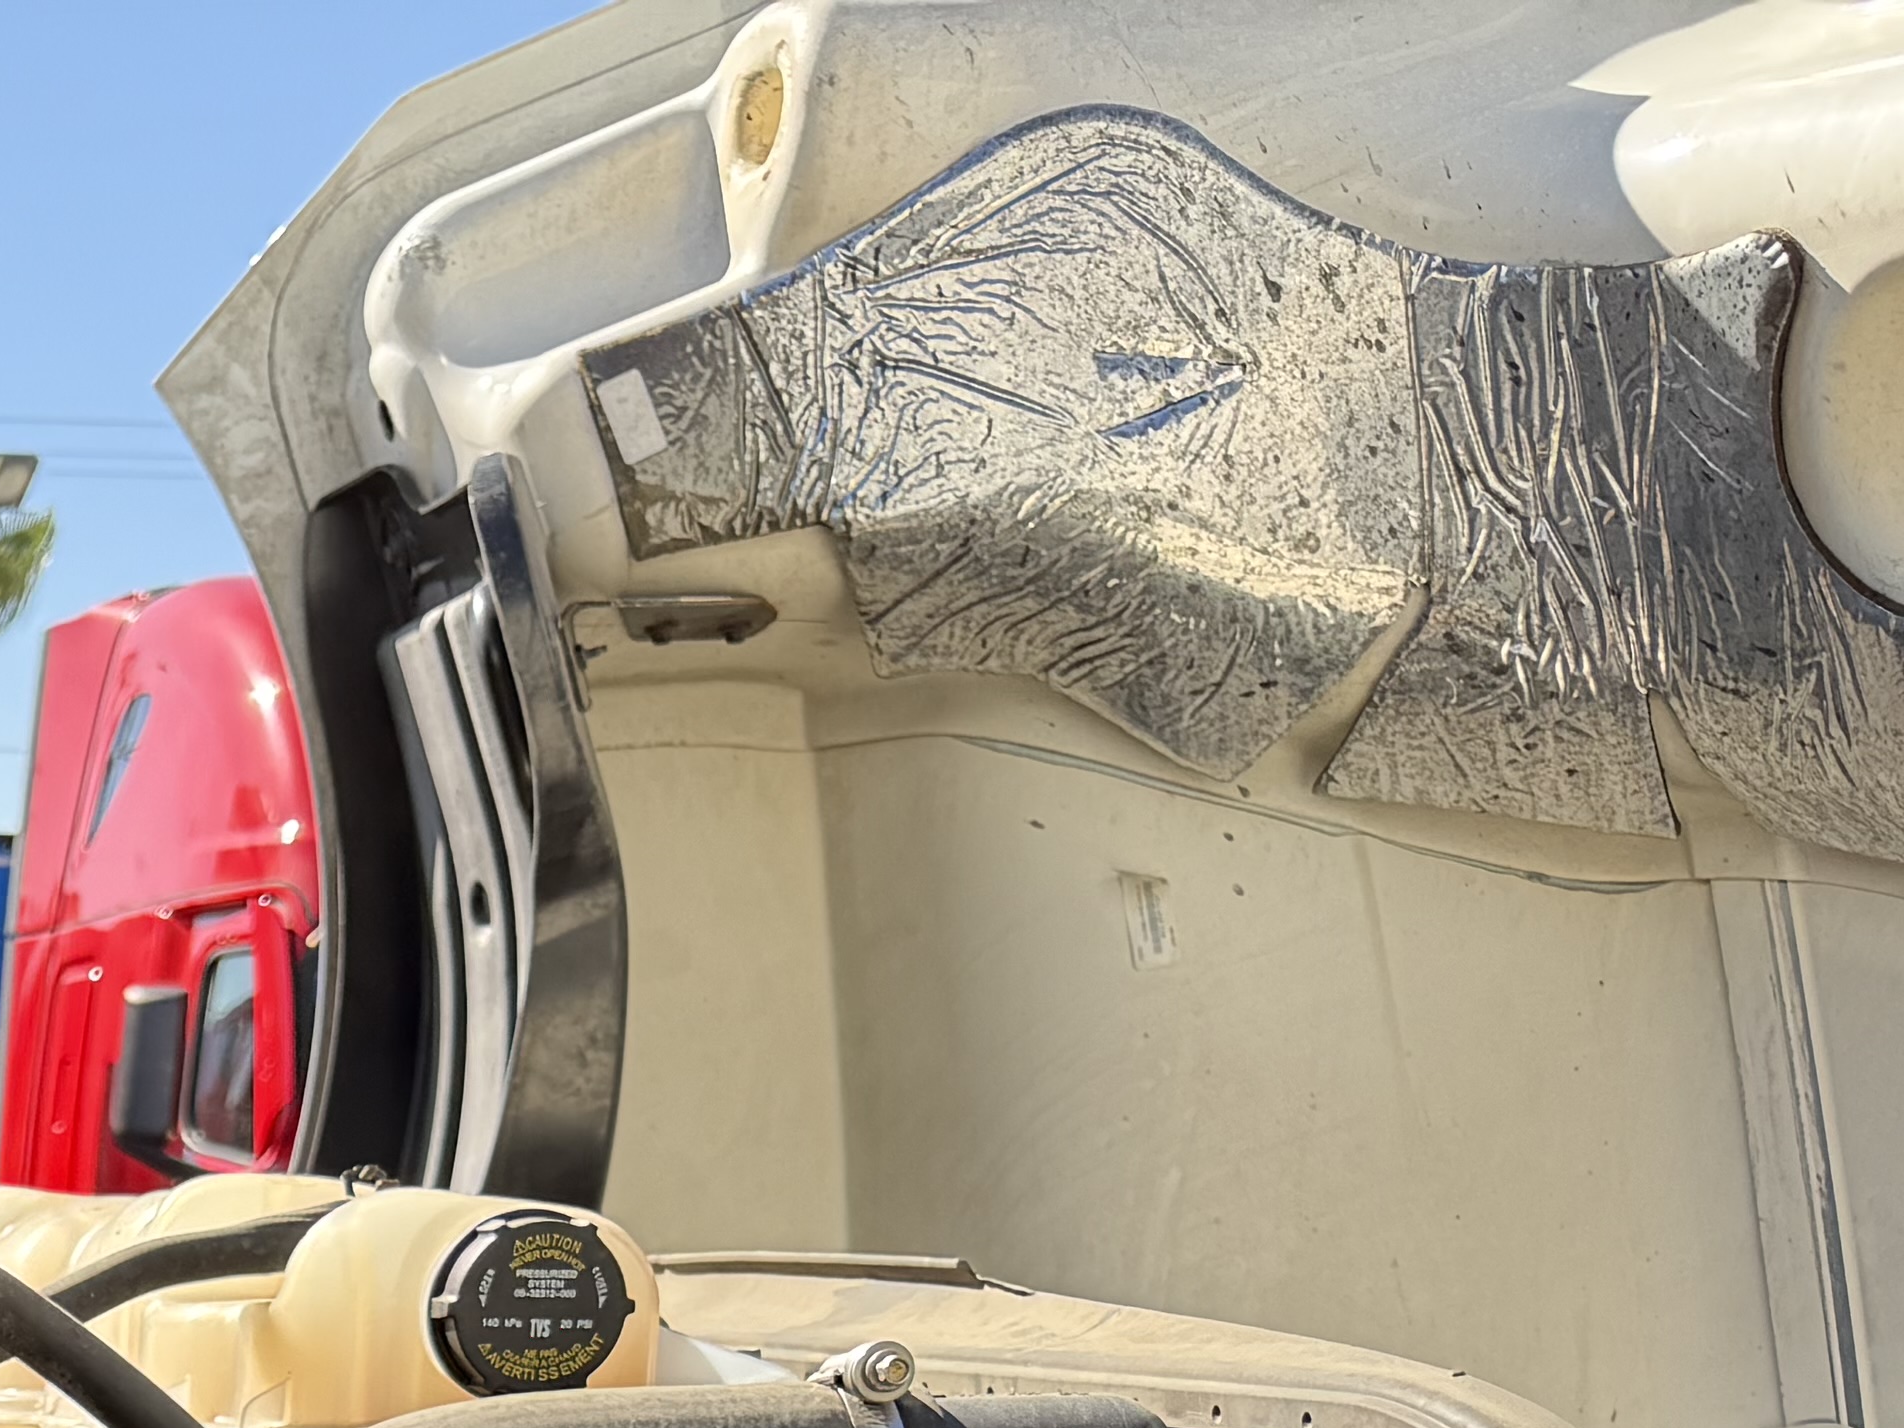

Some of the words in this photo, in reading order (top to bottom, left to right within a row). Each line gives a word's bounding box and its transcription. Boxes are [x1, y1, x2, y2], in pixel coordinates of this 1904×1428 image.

[525, 1233, 582, 1254] CAUTION
[516, 1269, 579, 1279] PRESSURIZED
[527, 1280, 565, 1289] SYSTEM
[530, 1319, 551, 1338] TVS
[560, 1319, 573, 1329] 20
[577, 1320, 594, 1329] PSI
